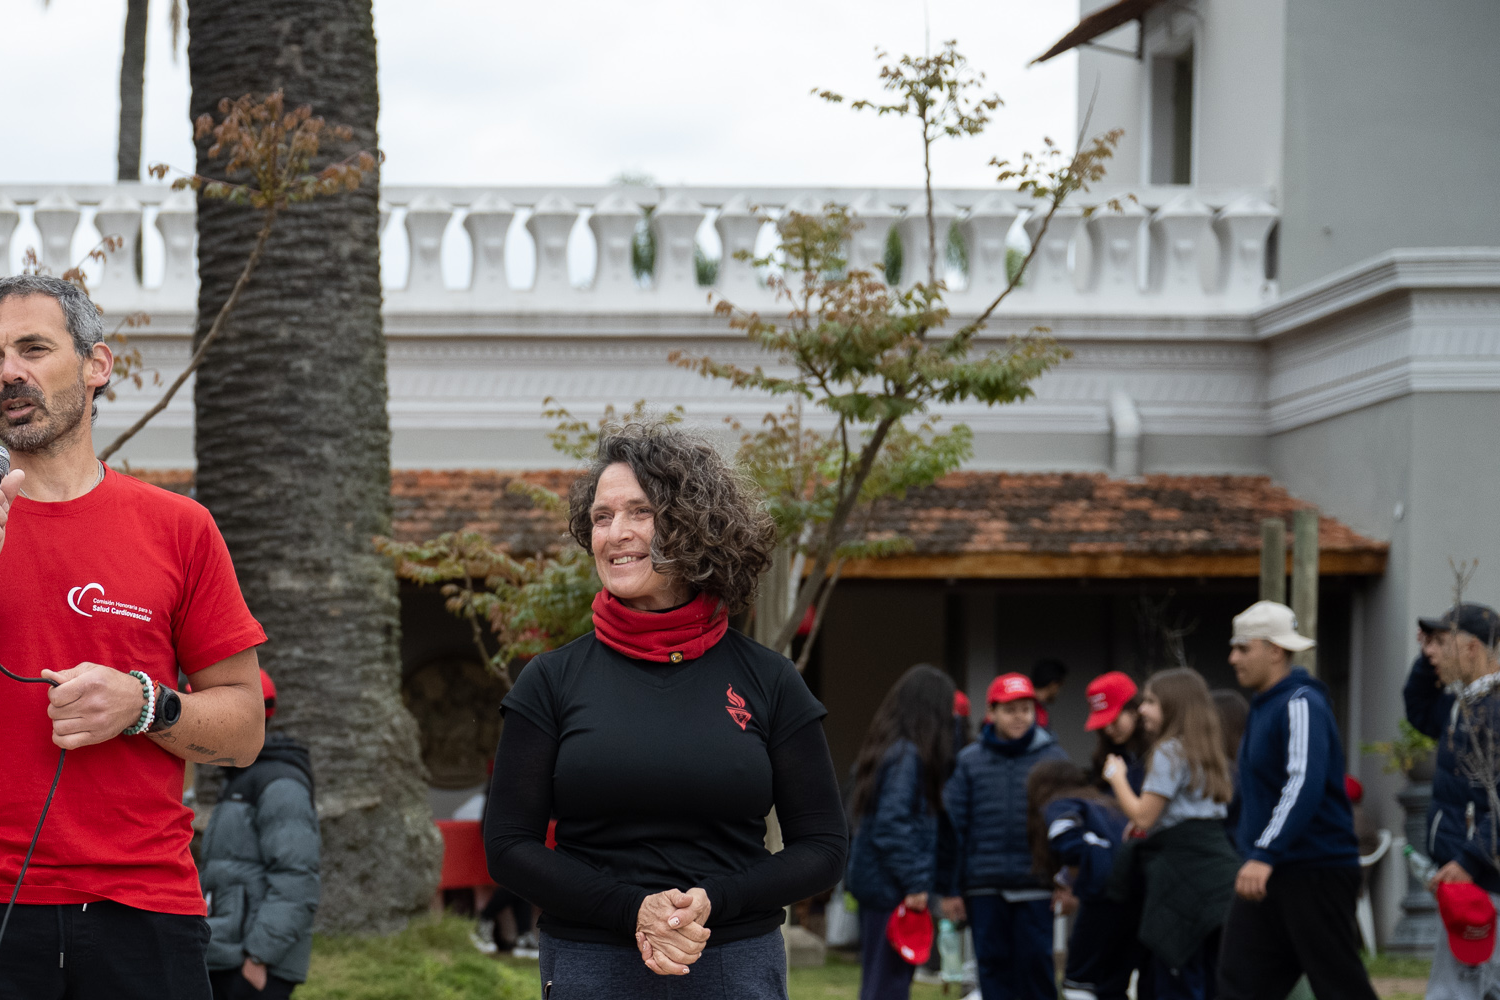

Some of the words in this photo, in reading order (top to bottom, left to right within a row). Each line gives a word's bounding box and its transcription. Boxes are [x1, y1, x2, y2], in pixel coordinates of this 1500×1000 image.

[93, 598, 114, 606] Comisión
[115, 602, 137, 610] Honoraria
[92, 605, 110, 613] Salud
[111, 608, 151, 622] Cardiovascular
